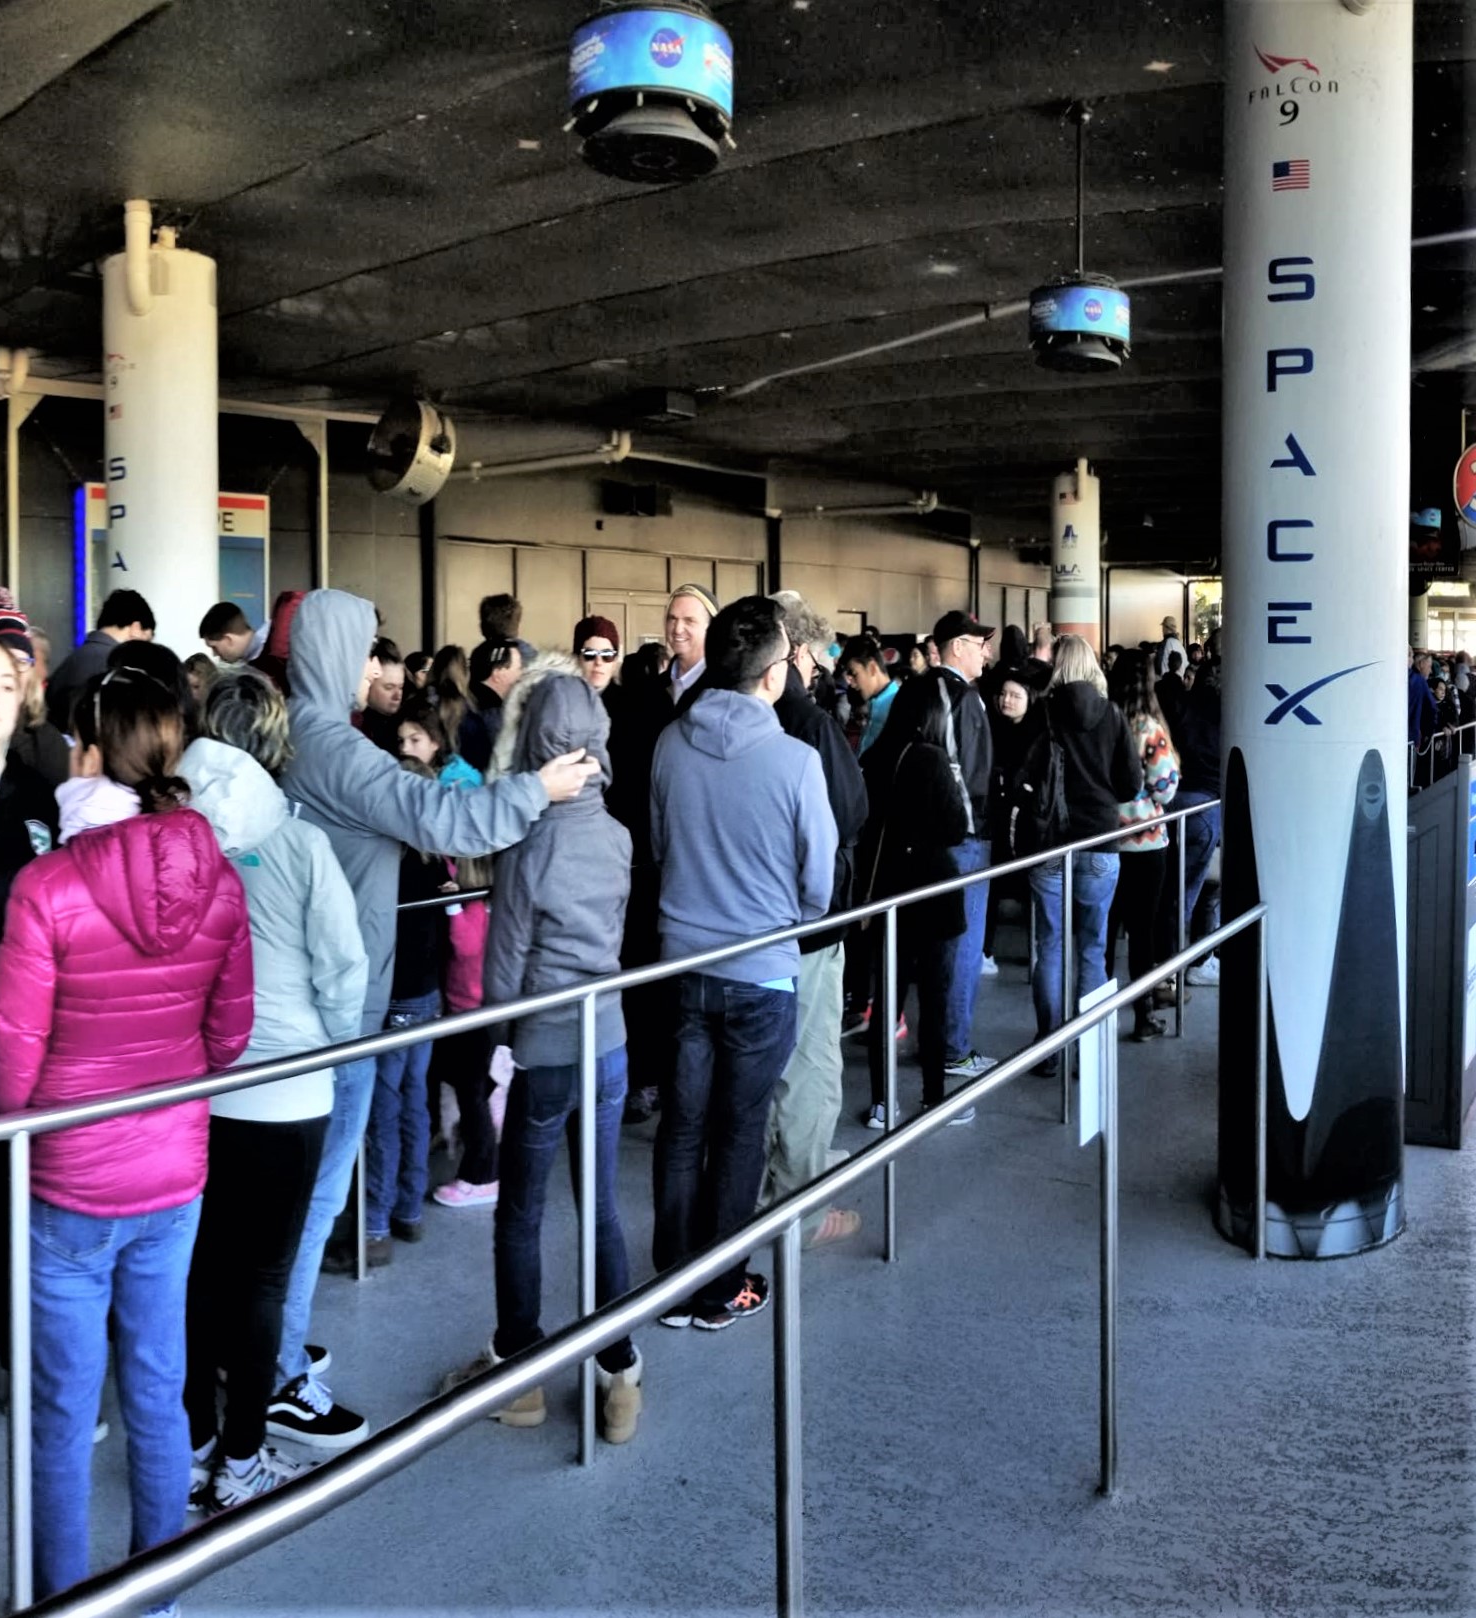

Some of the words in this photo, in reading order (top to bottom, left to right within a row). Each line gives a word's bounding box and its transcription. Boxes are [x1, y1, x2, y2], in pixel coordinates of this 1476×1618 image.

[651, 41, 681, 54] NASA
[1278, 99, 1300, 127] 9
[1055, 563, 1081, 575] ULA
